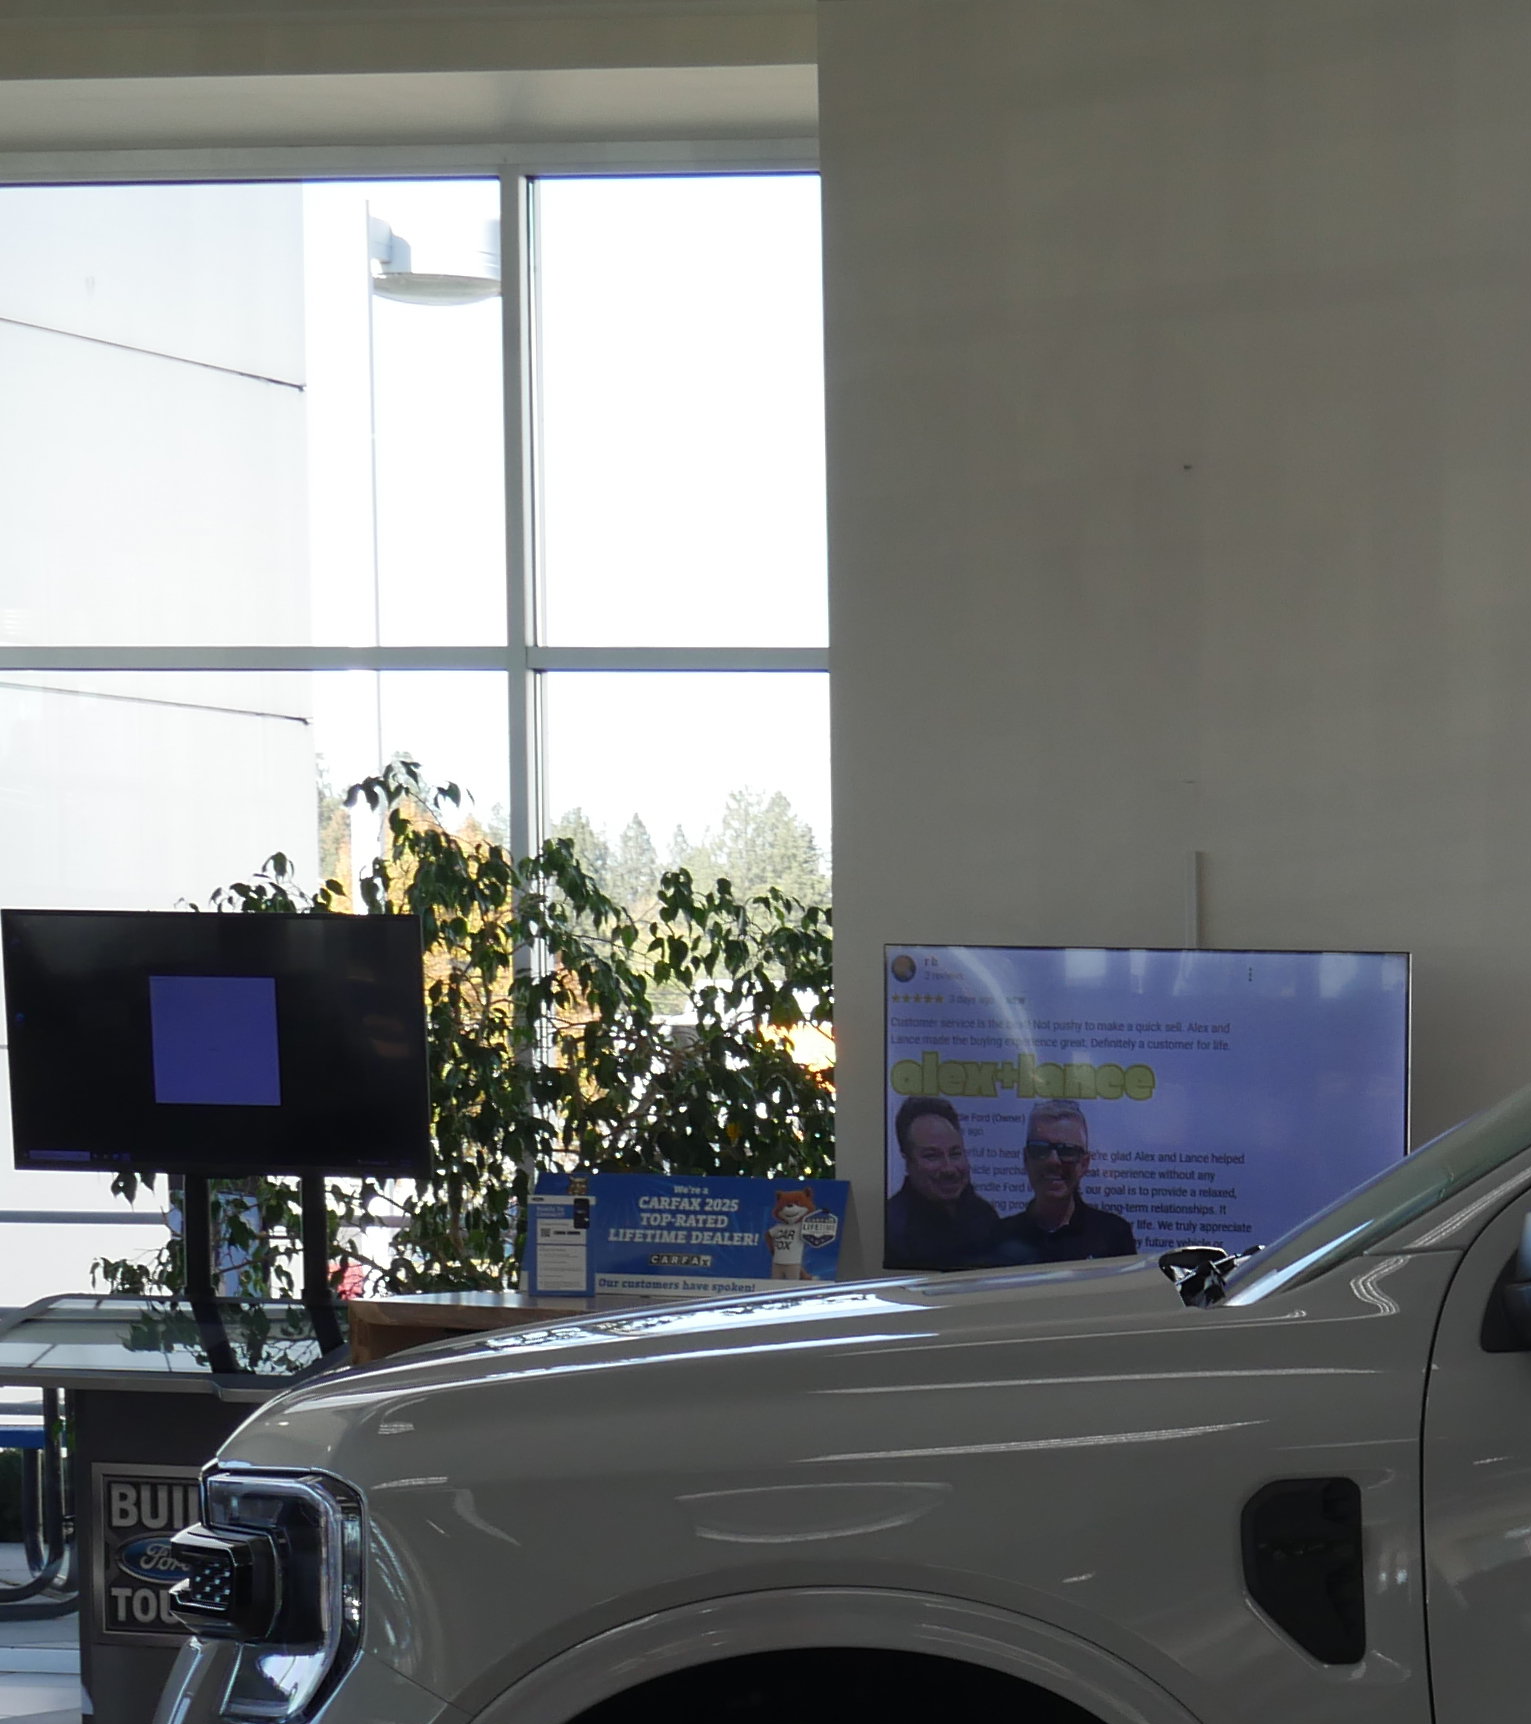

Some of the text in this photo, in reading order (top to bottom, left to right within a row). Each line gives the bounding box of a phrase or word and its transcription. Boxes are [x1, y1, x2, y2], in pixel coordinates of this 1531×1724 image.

[890, 1016, 939, 1028] Customer
[941, 1018, 975, 1028] service
[1033, 1020, 1051, 1030] Not
[1053, 1021, 1082, 1034] pushy
[1085, 1021, 1095, 1031] to
[1097, 1021, 1125, 1032] make
[1127, 1024, 1133, 1032] a
[1135, 1021, 1162, 1034] quick
[1187, 1022, 1209, 1033] Alex
[1211, 1022, 1231, 1033] and
[890, 1035, 921, 1045] Lance
[922, 1035, 950, 1045] made
[952, 1035, 968, 1045] the
[970, 1036, 1003, 1048] buying
[1091, 1038, 1136, 1051] Definitely
[1138, 1041, 1145, 1050] a
[1147, 1040, 1194, 1050] customer
[1196, 1039, 1211, 1050] for
[1213, 1039, 1231, 1051] life.
[971, 1113, 990, 1122] Ford
[987, 1148, 997, 1158] to
[999, 1148, 1021, 1159] hear
[1090, 1151, 1109, 1161] e're
[1111, 1151, 1132, 1162] glad
[1135, 1151, 1155, 1162] Alex
[1158, 1152, 1177, 1162] and
[1179, 1152, 1209, 1163] Lance
[1211, 1153, 1245, 1165] helped
[1102, 1169, 1156, 1181] experience
[1158, 1169, 1195, 1180] without
[1198, 1171, 1216, 1183] any
[673, 1185, 701, 1195] We're
[1003, 1182, 1026, 1192] Ford
[1086, 1186, 1102, 1196] our
[1104, 1185, 1126, 1197] goal
[1128, 1186, 1137, 1195] is
[1139, 1186, 1149, 1196] to
[1151, 1186, 1188, 1199] provide
[1190, 1189, 1196, 1197] a
[1199, 1187, 1238, 1200] relaxed,
[638, 1196, 740, 1212] CARFAX 2025
[1101, 1202, 1148, 1215] long-term
[1151, 1203, 1215, 1216] relationships.
[640, 1212, 728, 1228] TOP-RATED
[1136, 1219, 1252, 1235] life. We truly appreciate
[608, 1228, 760, 1246] LIFETIME DEALER!
[1145, 1236, 1174, 1248] future
[598, 1278, 756, 1295] Our customers have spoken!
